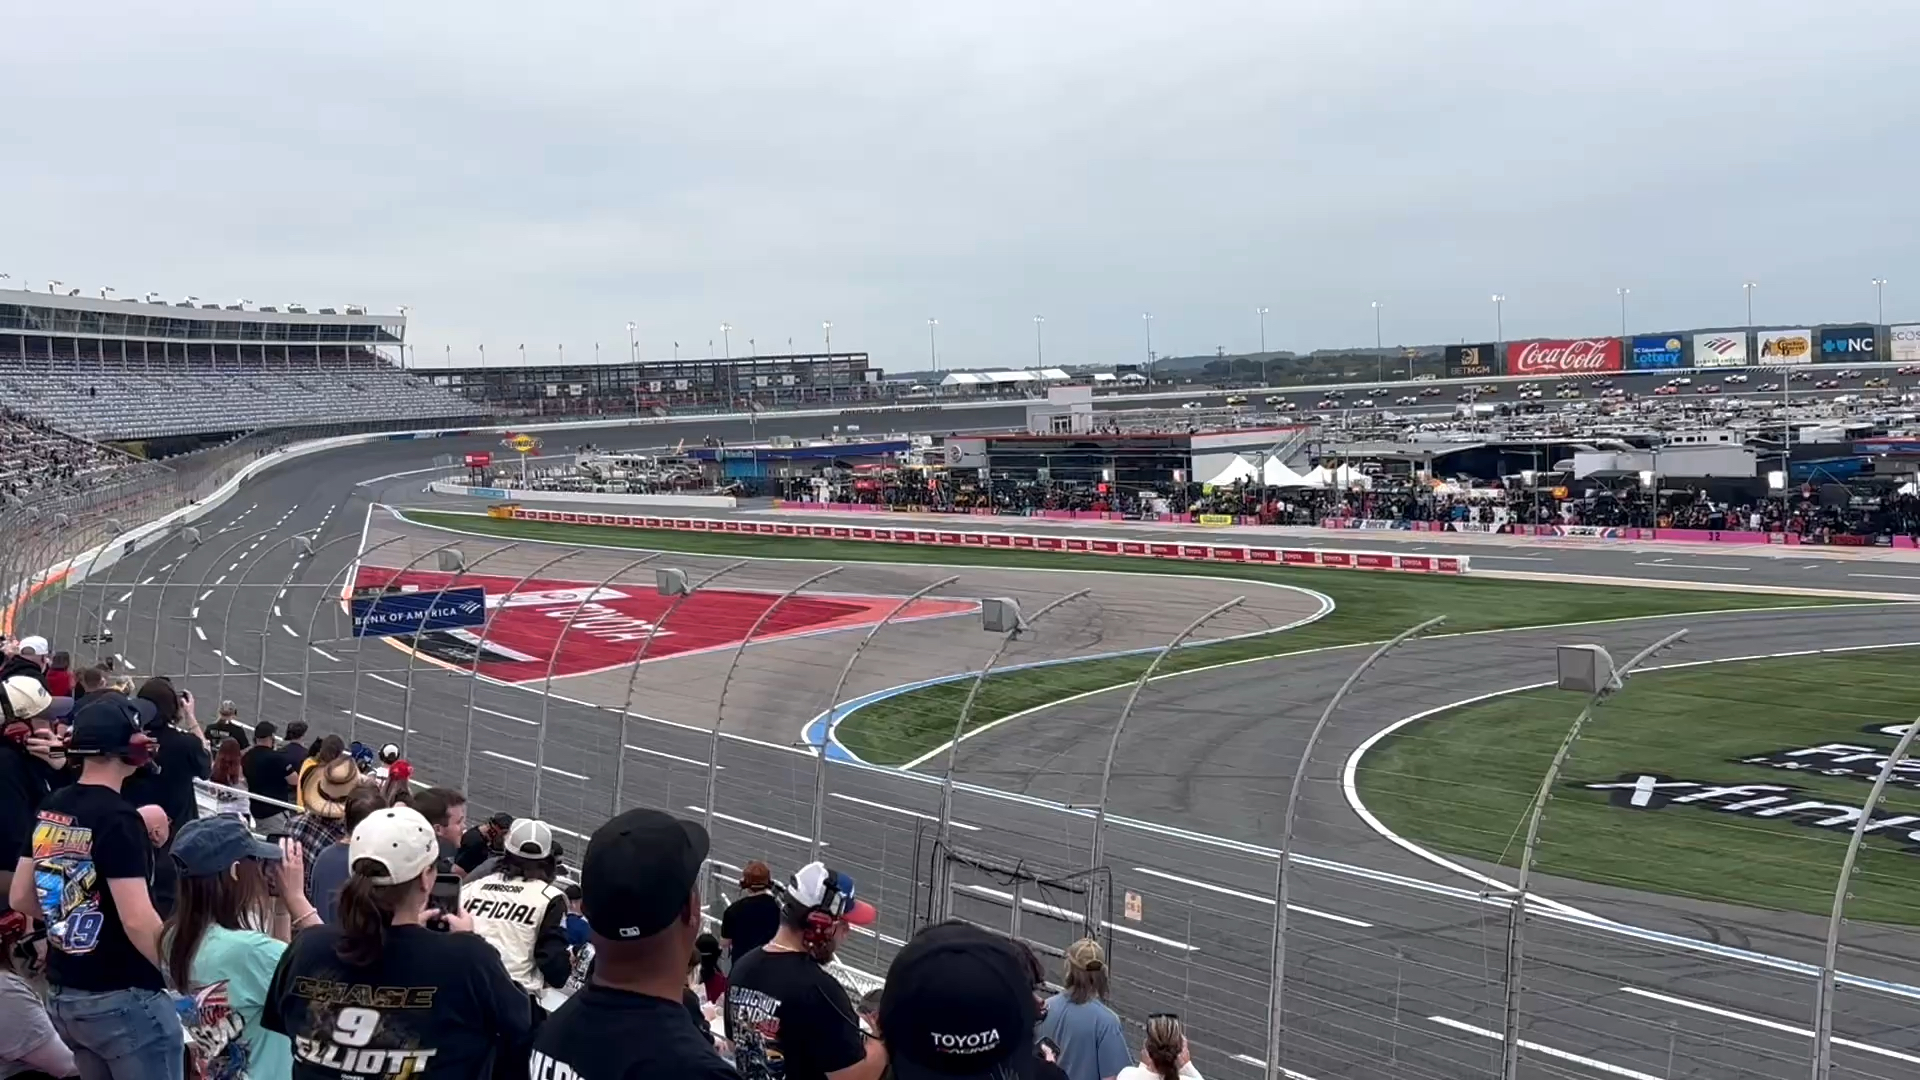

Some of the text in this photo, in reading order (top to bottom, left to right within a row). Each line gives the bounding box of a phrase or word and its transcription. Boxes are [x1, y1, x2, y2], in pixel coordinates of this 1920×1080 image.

[1518, 340, 1610, 371] Coca-Cola
[1633, 352, 1680, 366] Lottery
[1848, 338, 1873, 352] NC
[389, 611, 403, 622] OF
[406, 606, 458, 620] AMRICA
[463, 898, 537, 926] FFICIAL
[63, 912, 104, 950] 19
[292, 976, 438, 1009] CHASE
[332, 1006, 381, 1047] 9
[930, 1028, 1000, 1047] TOYOTA
[295, 1034, 438, 1074] ELLIOTT
